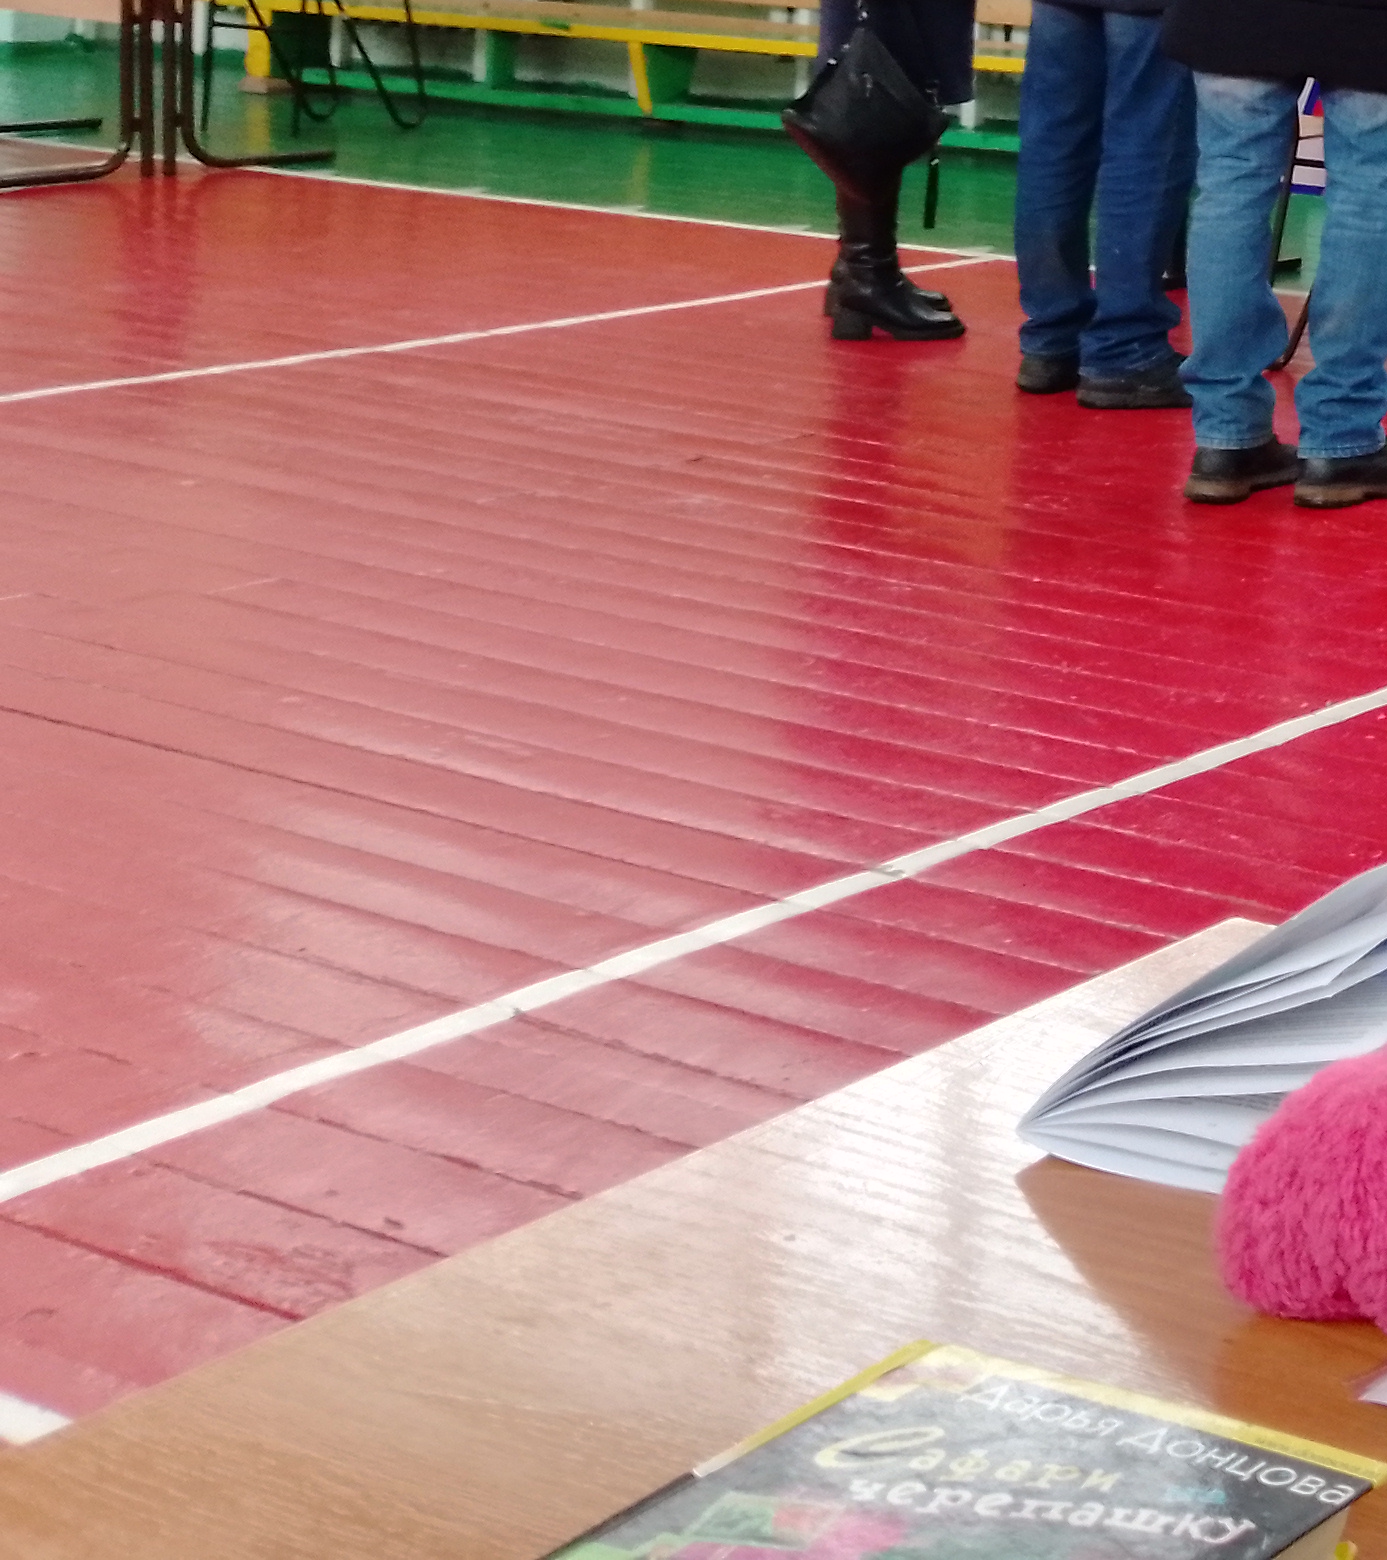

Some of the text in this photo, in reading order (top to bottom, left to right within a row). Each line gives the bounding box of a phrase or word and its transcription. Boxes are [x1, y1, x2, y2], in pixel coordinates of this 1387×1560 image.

[813, 1425, 1124, 1494] Сафари
[958, 1383, 1124, 1438] Дарья
[1116, 1427, 1356, 1507] Донцова
[849, 1479, 1257, 1544] черепашку
